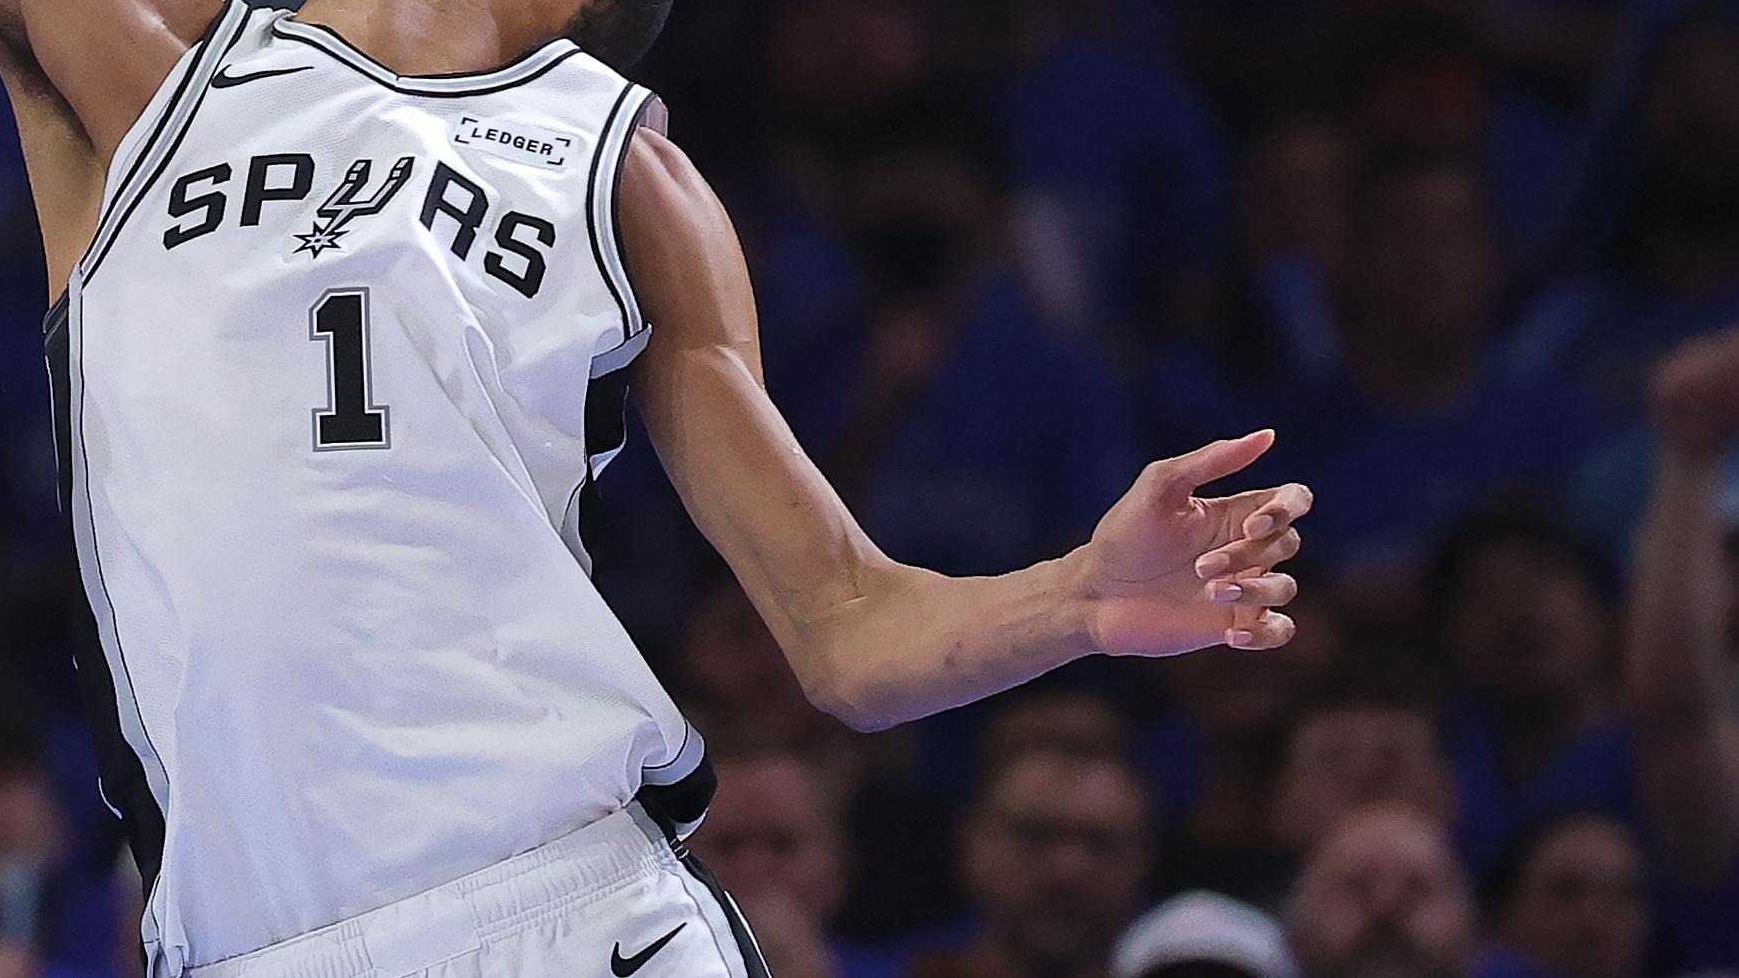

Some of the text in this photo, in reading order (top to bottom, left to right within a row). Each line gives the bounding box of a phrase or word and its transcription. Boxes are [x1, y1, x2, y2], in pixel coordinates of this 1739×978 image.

[471, 127, 554, 156] LEDGER
[162, 153, 556, 299] SPURS
[309, 286, 390, 452] 1
